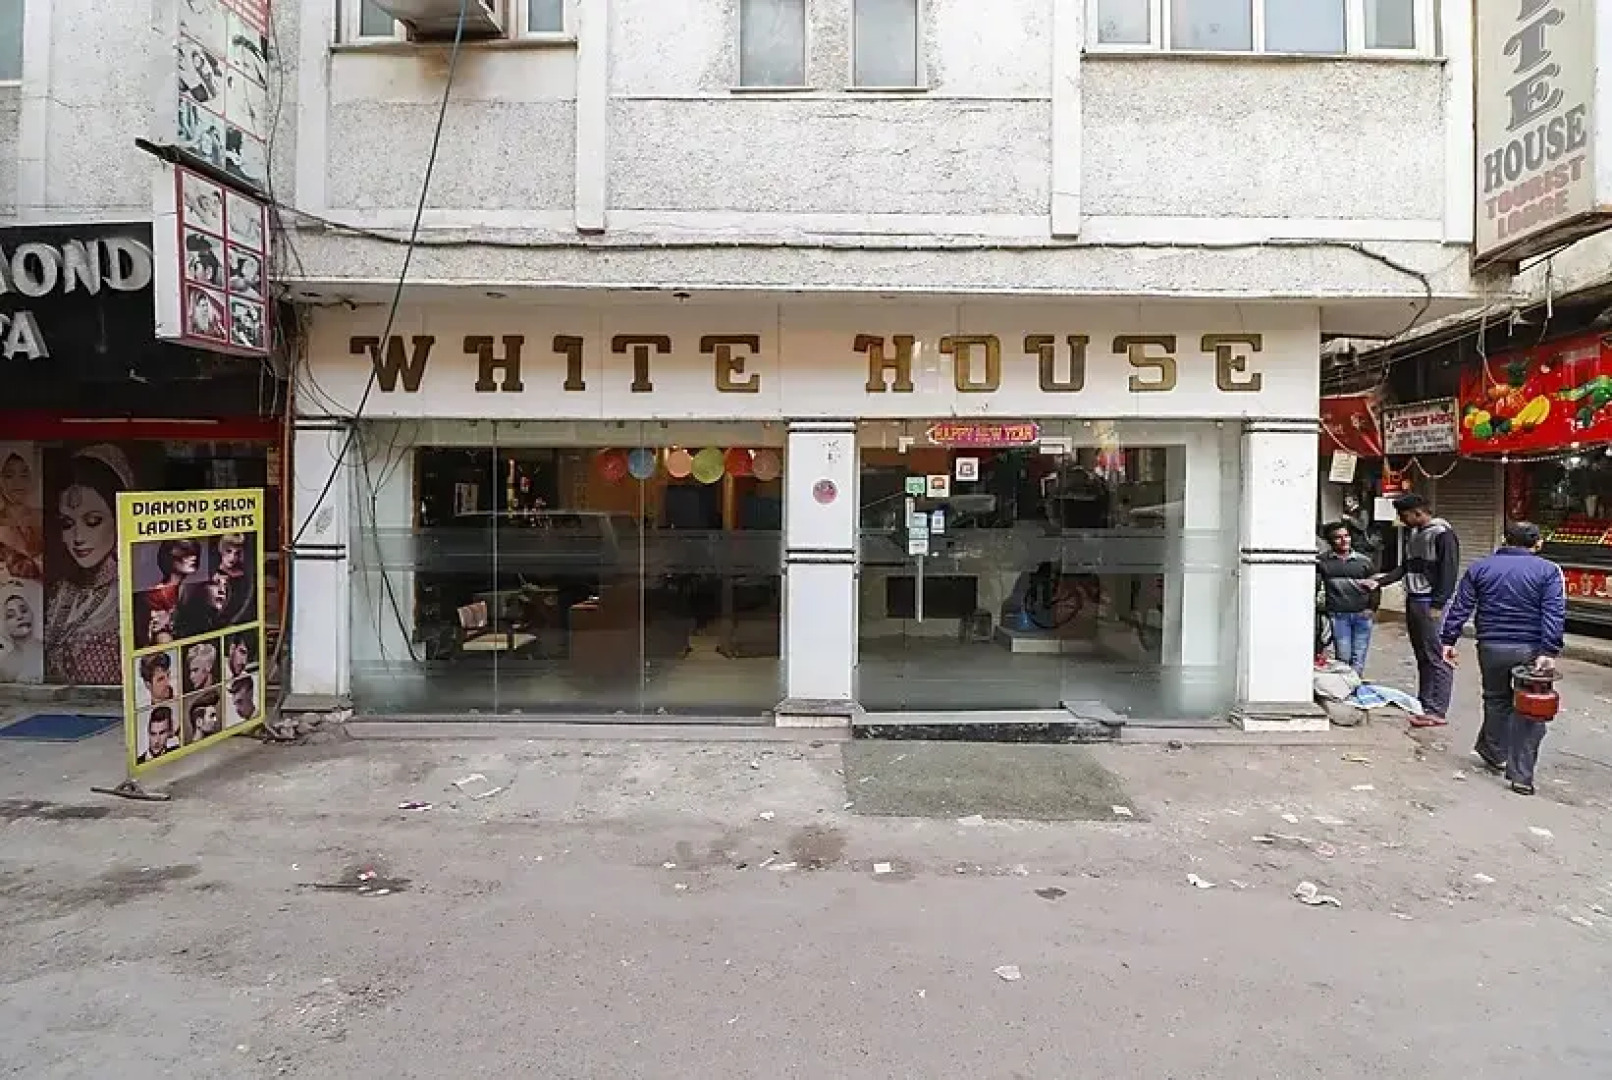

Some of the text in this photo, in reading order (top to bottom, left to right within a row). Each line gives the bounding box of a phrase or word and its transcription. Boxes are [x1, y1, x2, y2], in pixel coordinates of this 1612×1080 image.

[1484, 103, 1587, 193] HOUSE
[1485, 155, 1586, 221] TOURIST
[1496, 189, 1570, 241] LODGE
[0, 236, 153, 297] OND
[349, 333, 1263, 393] WHITE HOUSE
[934, 424, 973, 441] HAPPY
[1004, 424, 1033, 441] YEAR
[132, 497, 256, 516] DIAMOND SALON
[138, 514, 254, 536] LADIES & GENTS
